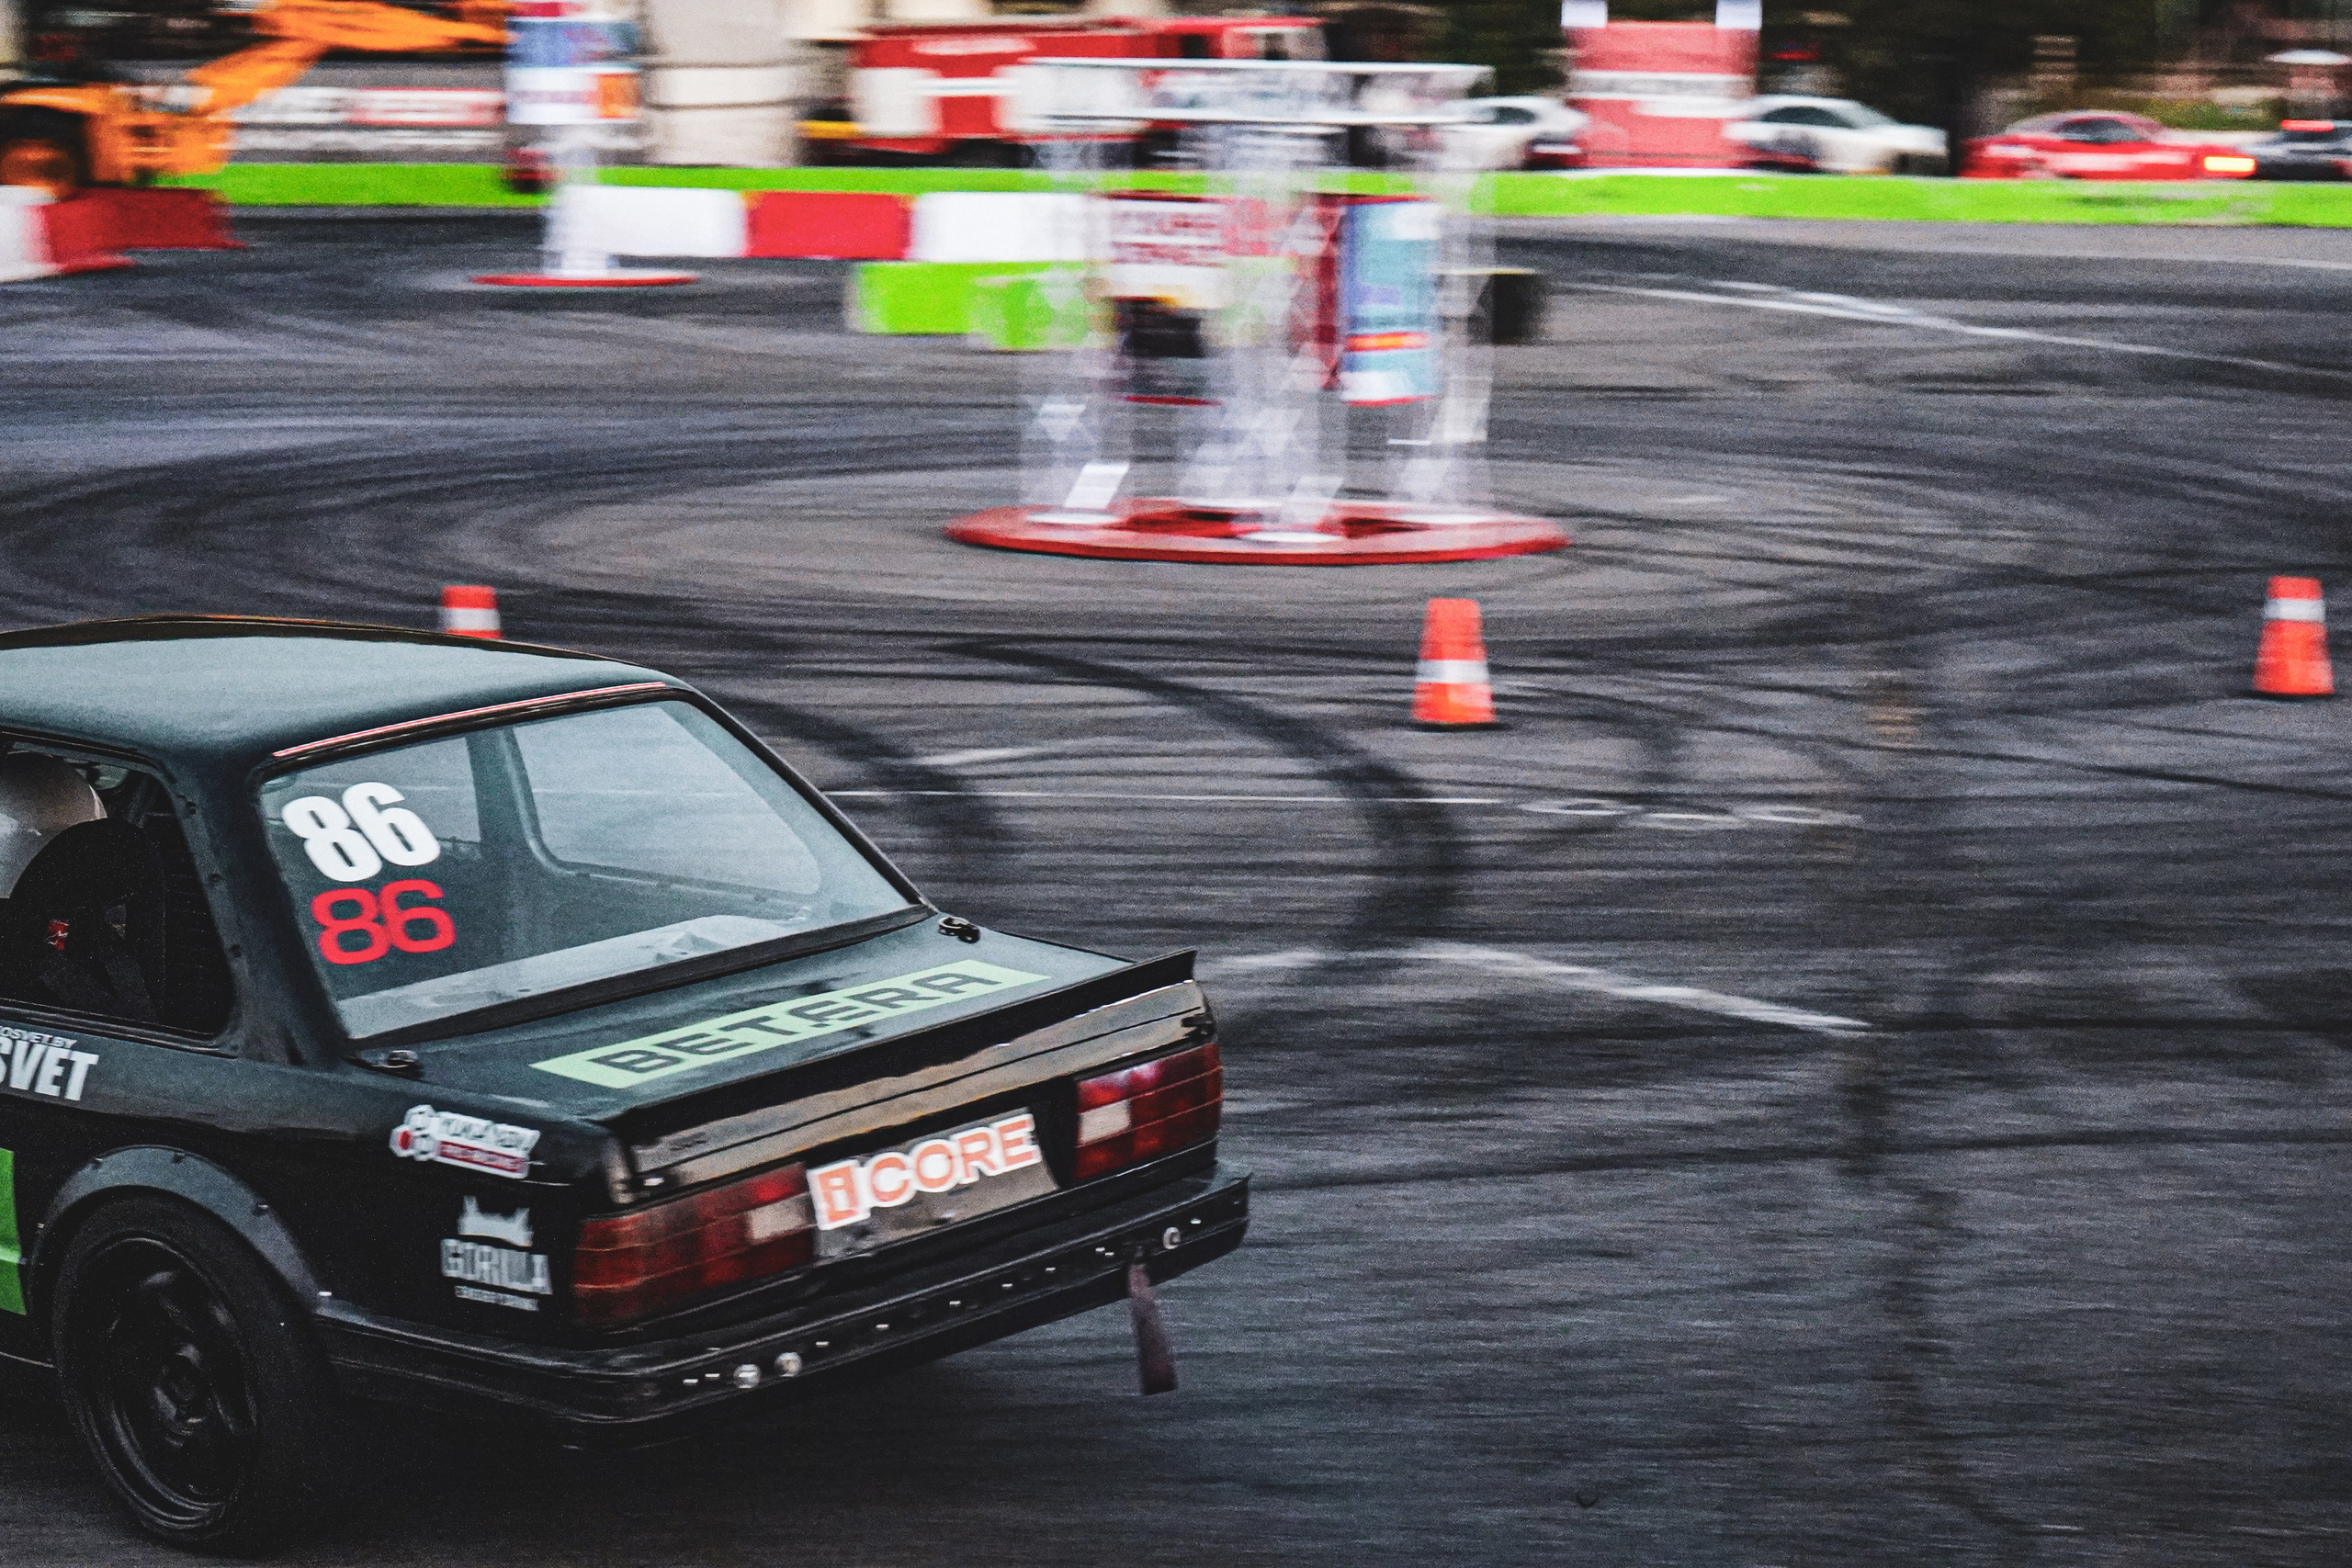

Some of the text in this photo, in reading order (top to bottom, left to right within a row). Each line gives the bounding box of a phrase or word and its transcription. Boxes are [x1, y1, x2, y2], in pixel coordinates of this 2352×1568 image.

[281, 782, 441, 882] 86
[311, 879, 457, 964] 86
[0, 1025, 77, 1049] OSVET.BY
[441, 1238, 553, 1294] GORILLA
